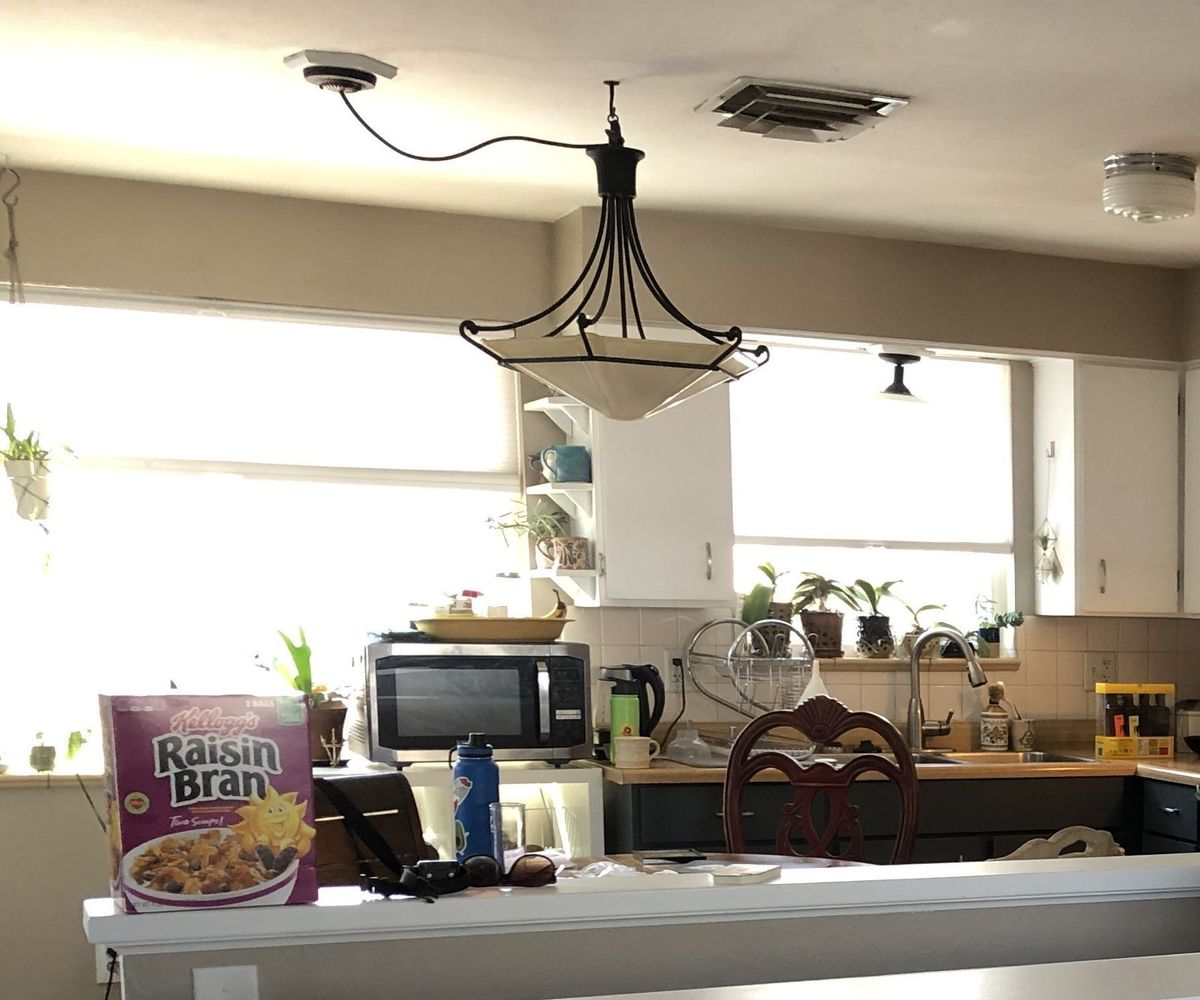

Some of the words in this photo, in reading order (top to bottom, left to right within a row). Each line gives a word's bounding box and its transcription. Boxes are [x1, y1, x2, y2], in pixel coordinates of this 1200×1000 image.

[171, 706, 260, 735] Kellogg's
[156, 734, 280, 773] Raisin
[173, 768, 267, 804] Bran
